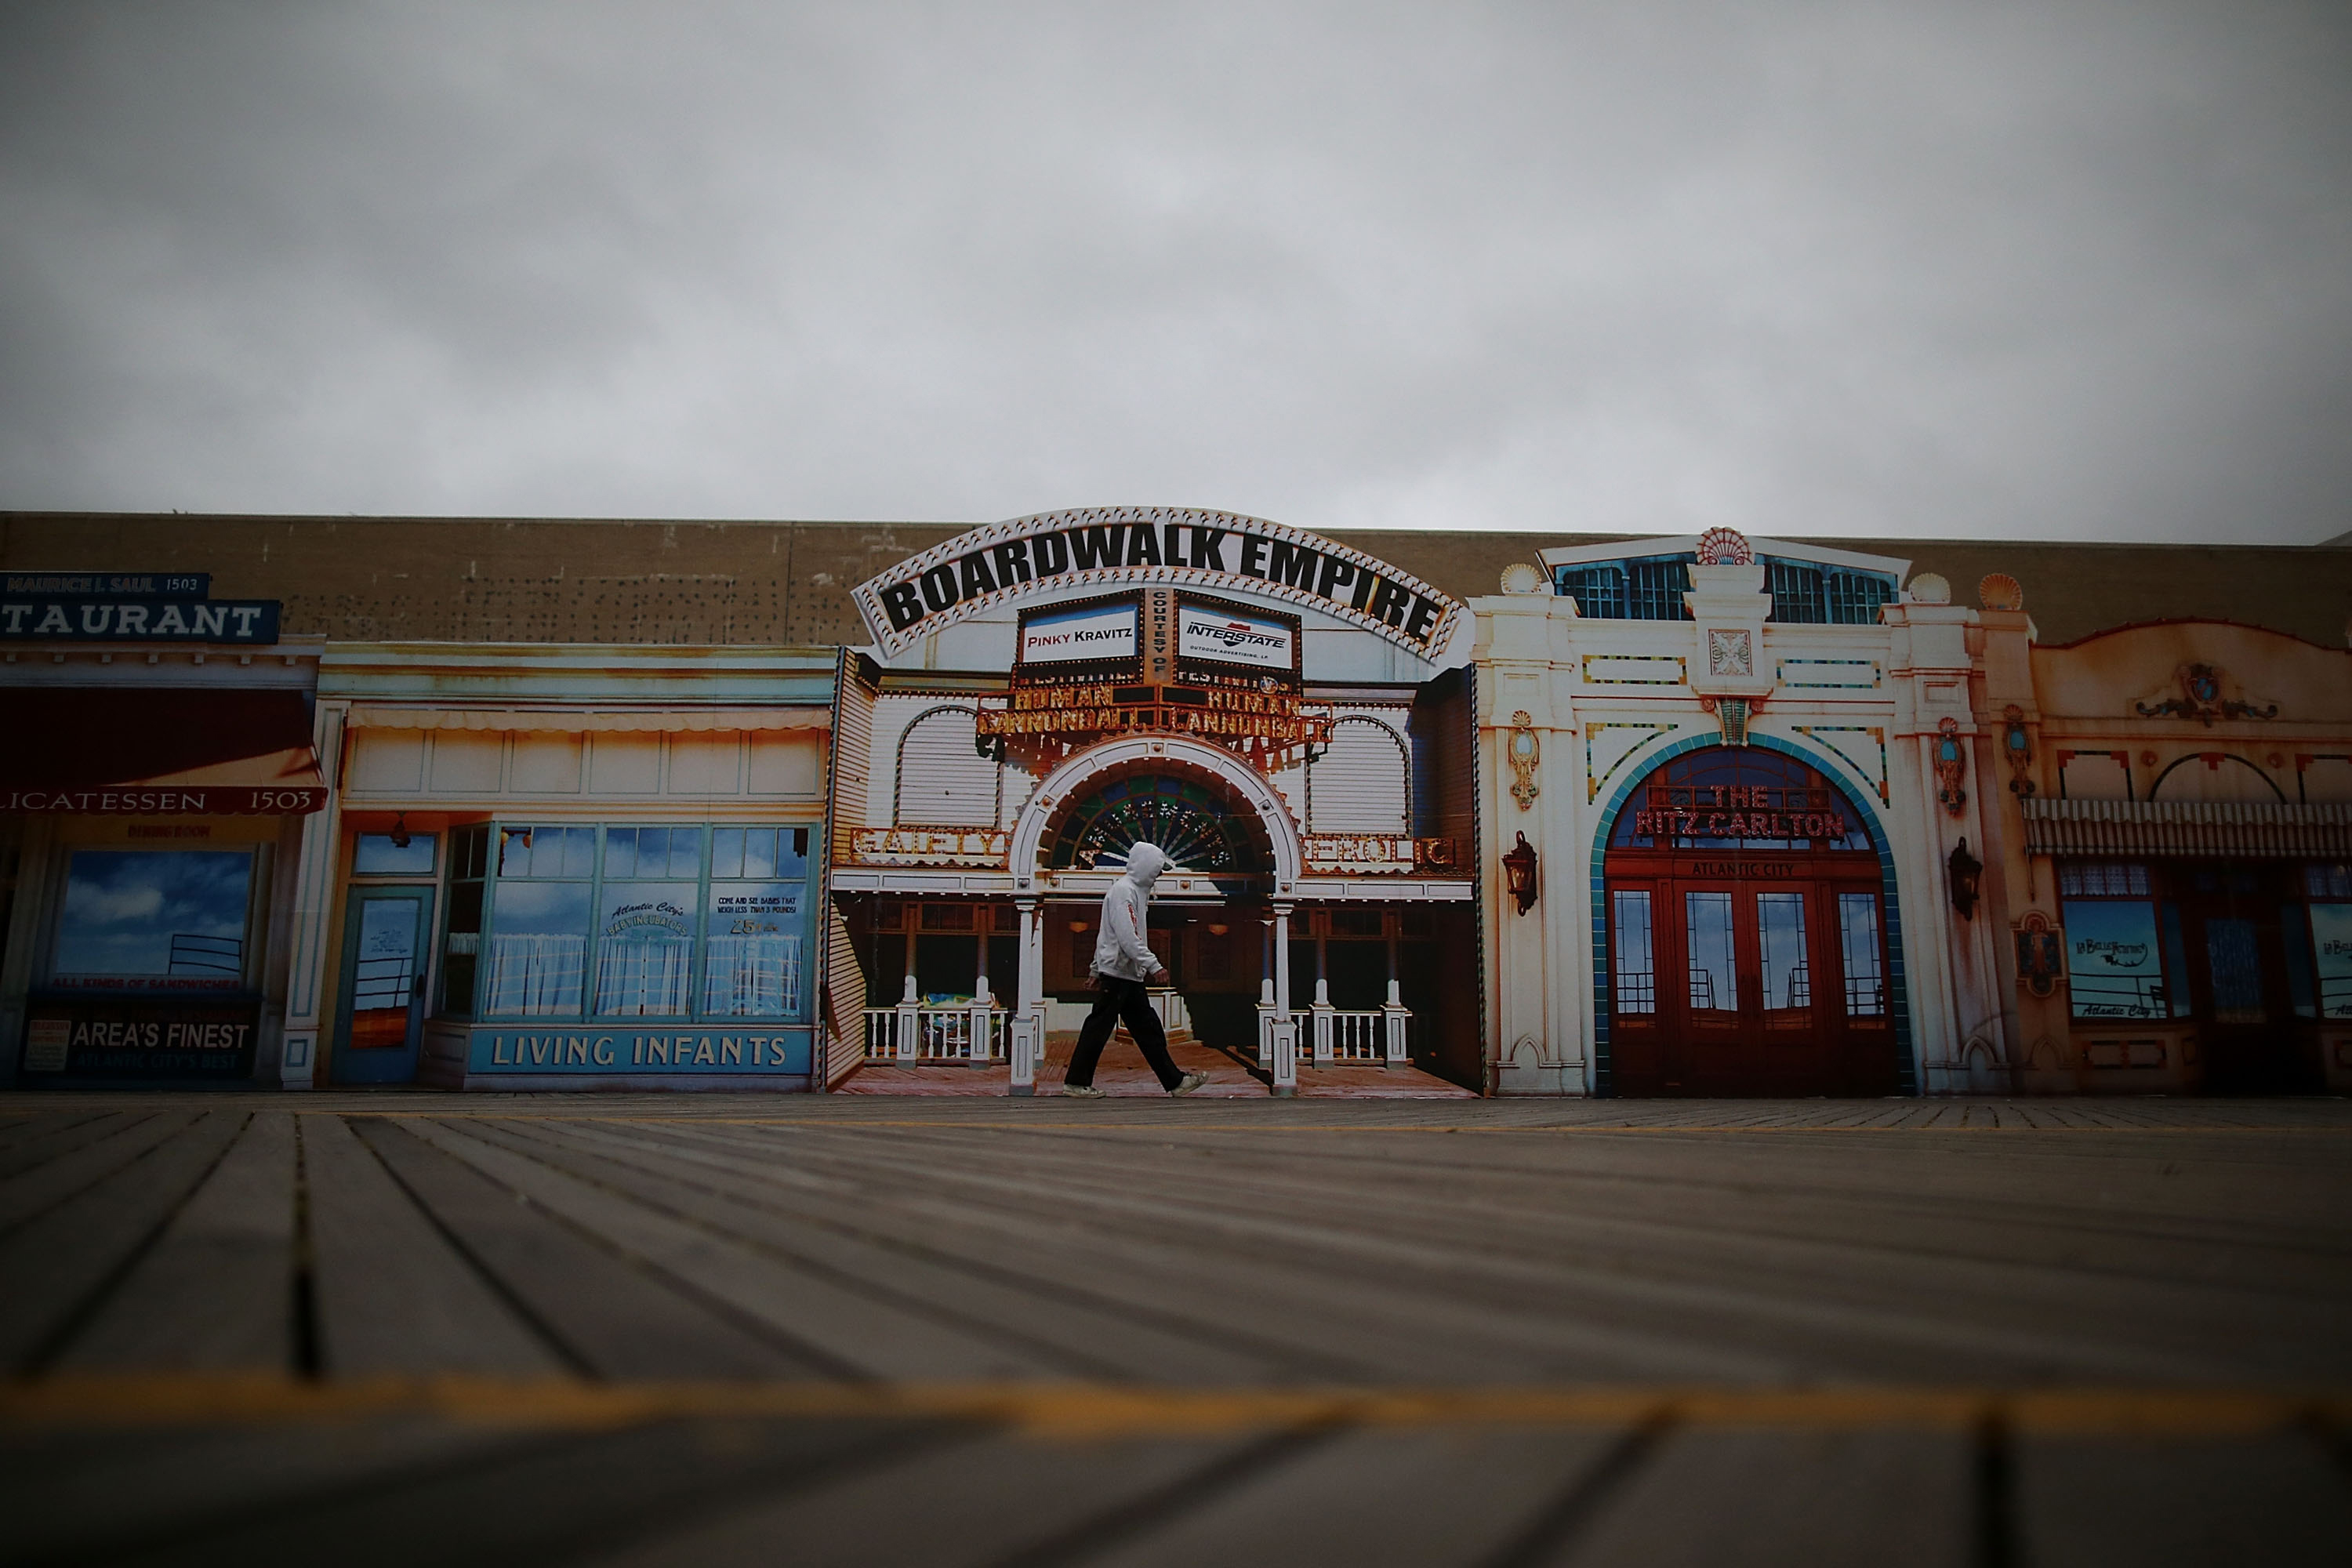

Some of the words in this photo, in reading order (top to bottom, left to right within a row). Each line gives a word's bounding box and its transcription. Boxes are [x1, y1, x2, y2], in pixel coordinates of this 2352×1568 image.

[6, 577, 92, 593] MAURICE
[110, 578, 157, 593] SAUL
[166, 579, 198, 591] 1503
[879, 524, 1226, 633] BOARDWALK
[1240, 536, 1442, 648] EMPIRE
[2, 604, 263, 637] TAURANT
[1152, 591, 1167, 653] COURTESY
[1190, 644, 1218, 654] OUTDOOR
[1152, 658, 1167, 673] OF
[1015, 684, 1113, 710] HUMAN
[1207, 691, 1301, 717] HUMAN
[0, 792, 206, 811] ICATESSEN
[249, 791, 312, 811] 1503
[1710, 785, 1768, 808] THE
[1637, 811, 1700, 834] RITZ
[1709, 813, 1844, 837] CARLTON
[851, 829, 1000, 855] GAIETY
[1312, 837, 1449, 864] FROLIC
[1692, 862, 1761, 877] ATLANTIC
[1763, 863, 1795, 877] CITY
[612, 902, 653, 920] Atlantic
[655, 902, 684, 916] City's
[606, 916, 633, 936] BABY
[631, 914, 688, 936] INCUBATORS
[127, 978, 145, 989] OF
[2082, 1004, 2125, 1016] Atlantic
[2128, 1004, 2151, 1018] City
[71, 1022, 161, 1048] AREA'S
[165, 1022, 250, 1049] FINEST
[76, 1053, 144, 1068] ATLANTIC
[199, 1054, 238, 1069] BEST
[492, 1036, 615, 1065] LIVING
[631, 1036, 787, 1065] INFANTS
